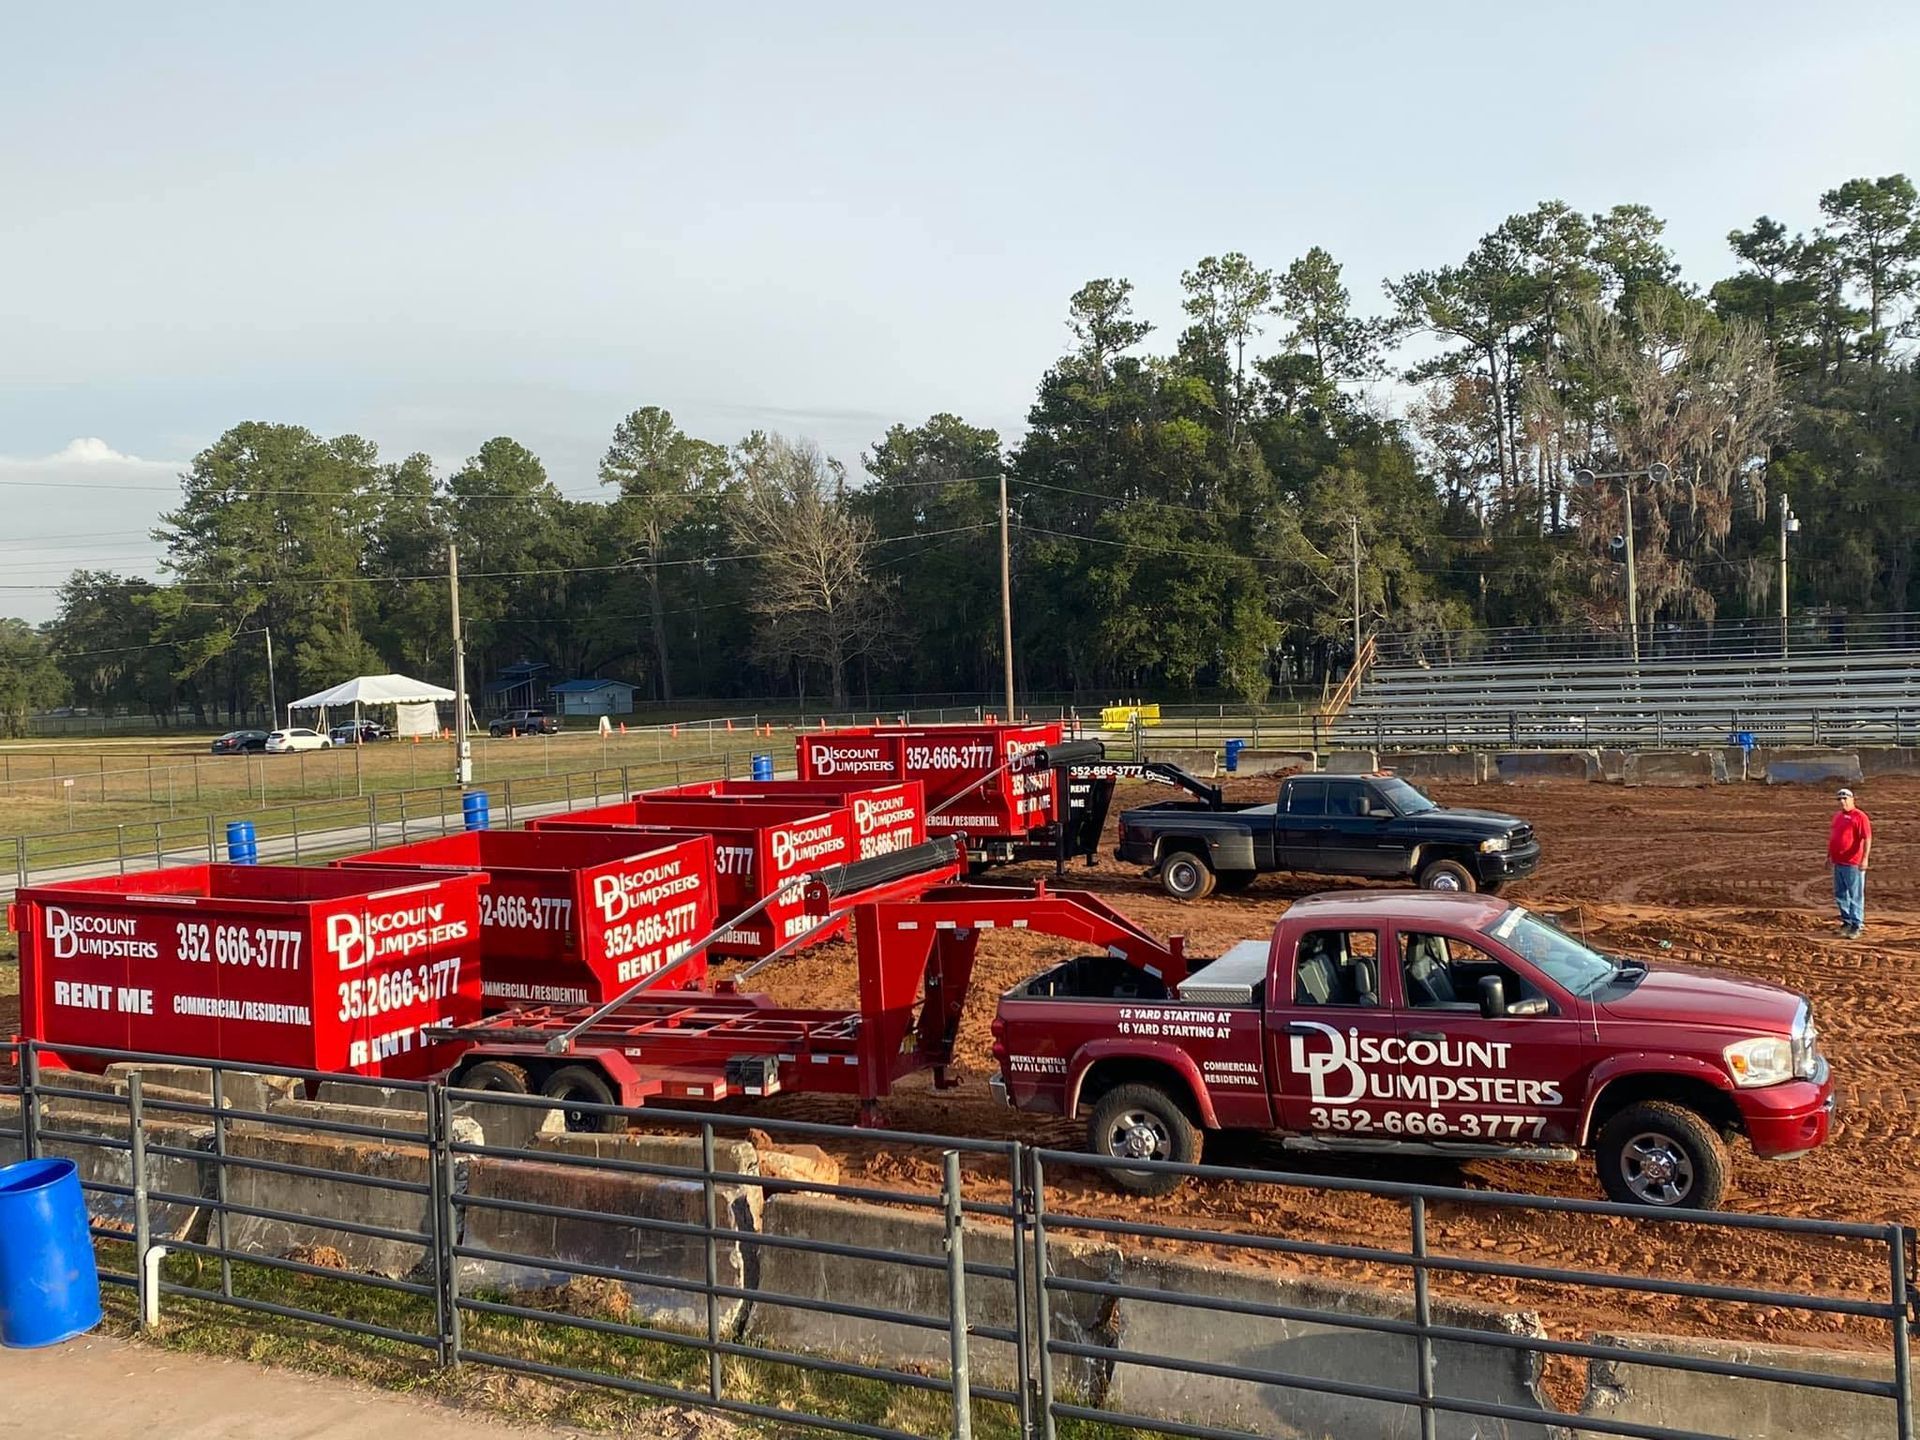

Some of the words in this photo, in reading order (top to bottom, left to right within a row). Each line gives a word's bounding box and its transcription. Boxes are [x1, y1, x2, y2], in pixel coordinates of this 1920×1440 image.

[811, 745, 880, 765] DISCOUNT
[818, 756, 894, 776] DUMPSTERS
[906, 745, 994, 769] 352-666-3777
[1070, 765, 1143, 776] 352-666-3777
[1070, 784, 1091, 794] RENT
[1070, 799, 1085, 808] ME
[854, 796, 905, 824] DISCOUNT
[859, 808, 915, 835] DUMPSTERS
[925, 815, 999, 827] ERCIAL/RESIDENTIAL
[772, 824, 833, 858] DISCOUNT
[778, 837, 845, 871] DUMPSTERS
[860, 827, 913, 861] 352-666-3777
[593, 860, 681, 909] DISCOUNT
[604, 874, 701, 922] DUMPSTERS
[46, 906, 137, 939] DISCOUNT
[478, 894, 572, 931] 2-666-3777
[54, 925, 158, 959] DUMPSTERS
[176, 922, 211, 962] 352
[215, 925, 302, 970] 666-3777
[603, 902, 697, 959] 352-666-3777
[617, 949, 662, 984] RENT
[54, 980, 113, 1011] RENT
[117, 987, 154, 1015] ME
[480, 980, 589, 1004] OMMERCIAL/RESIDENTIAL
[173, 994, 311, 1026] COMMERCIAL/RESIDENTIAL
[1119, 1008, 1132, 1018] 12
[1134, 1009, 1161, 1020] YARD
[1163, 1010, 1215, 1023] STARTING
[1216, 1012, 1232, 1024] AT
[1118, 1022, 1130, 1034] 16
[1133, 1023, 1160, 1036] YARD
[1161, 1024, 1215, 1038] STARTING
[1216, 1027, 1232, 1039] AT
[1289, 1021, 1512, 1074] DISCOUNT
[1010, 1062, 1068, 1074] AVAILABLE
[1203, 1061, 1258, 1073] COMMERCIAL
[1204, 1073, 1259, 1086] RESIDENTIAL
[1309, 1052, 1564, 1108] DUMPSTERS
[1309, 1106, 1548, 1139] 352-666-3777
